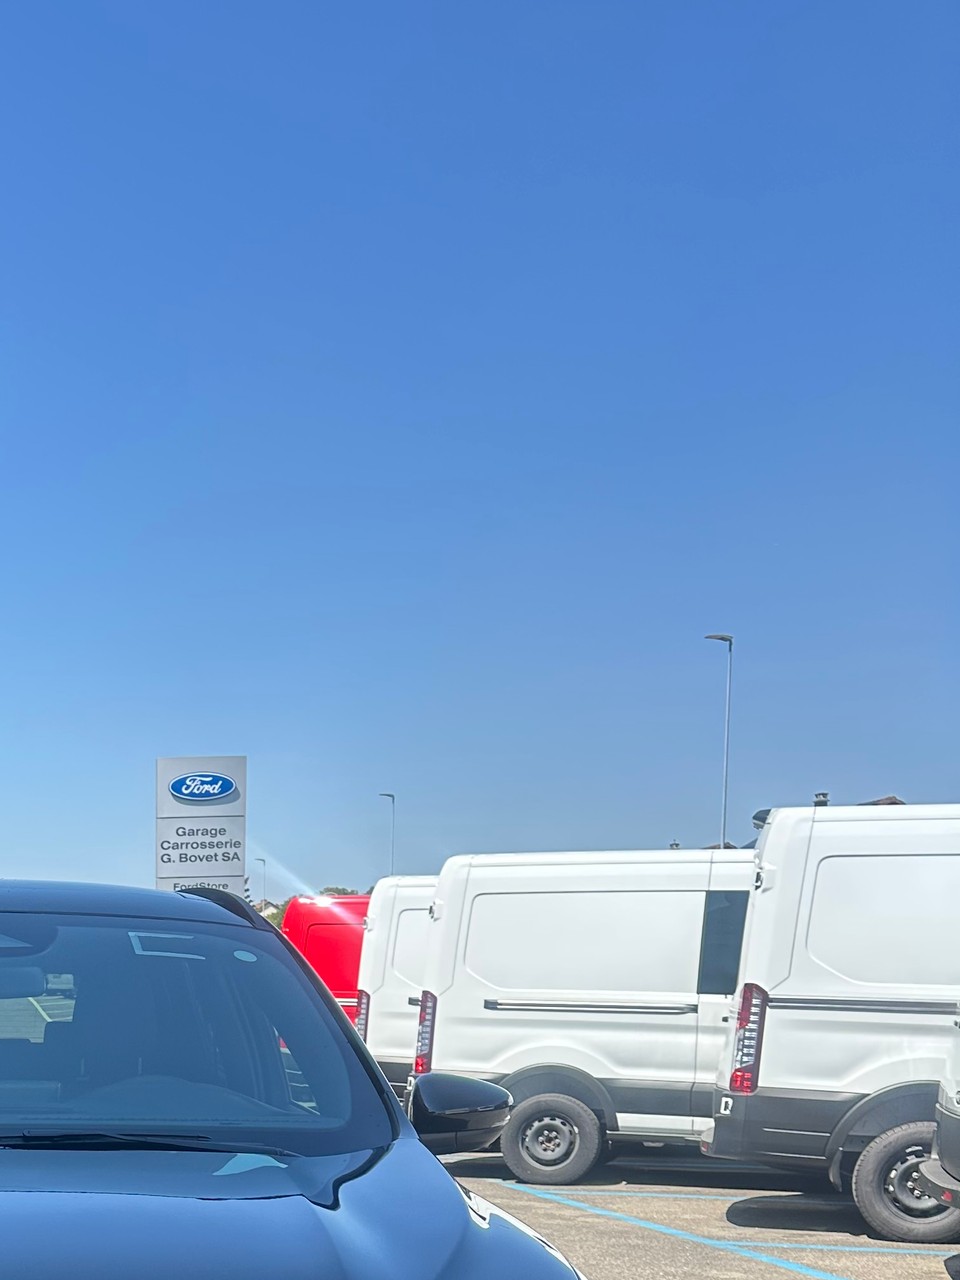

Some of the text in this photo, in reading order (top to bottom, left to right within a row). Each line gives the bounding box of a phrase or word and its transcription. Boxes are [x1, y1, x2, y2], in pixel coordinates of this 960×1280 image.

[182, 776, 222, 794] Ford
[175, 826, 227, 838] Garage
[160, 838, 242, 851] Carrosserie
[160, 851, 241, 864] G. Bovet SA
